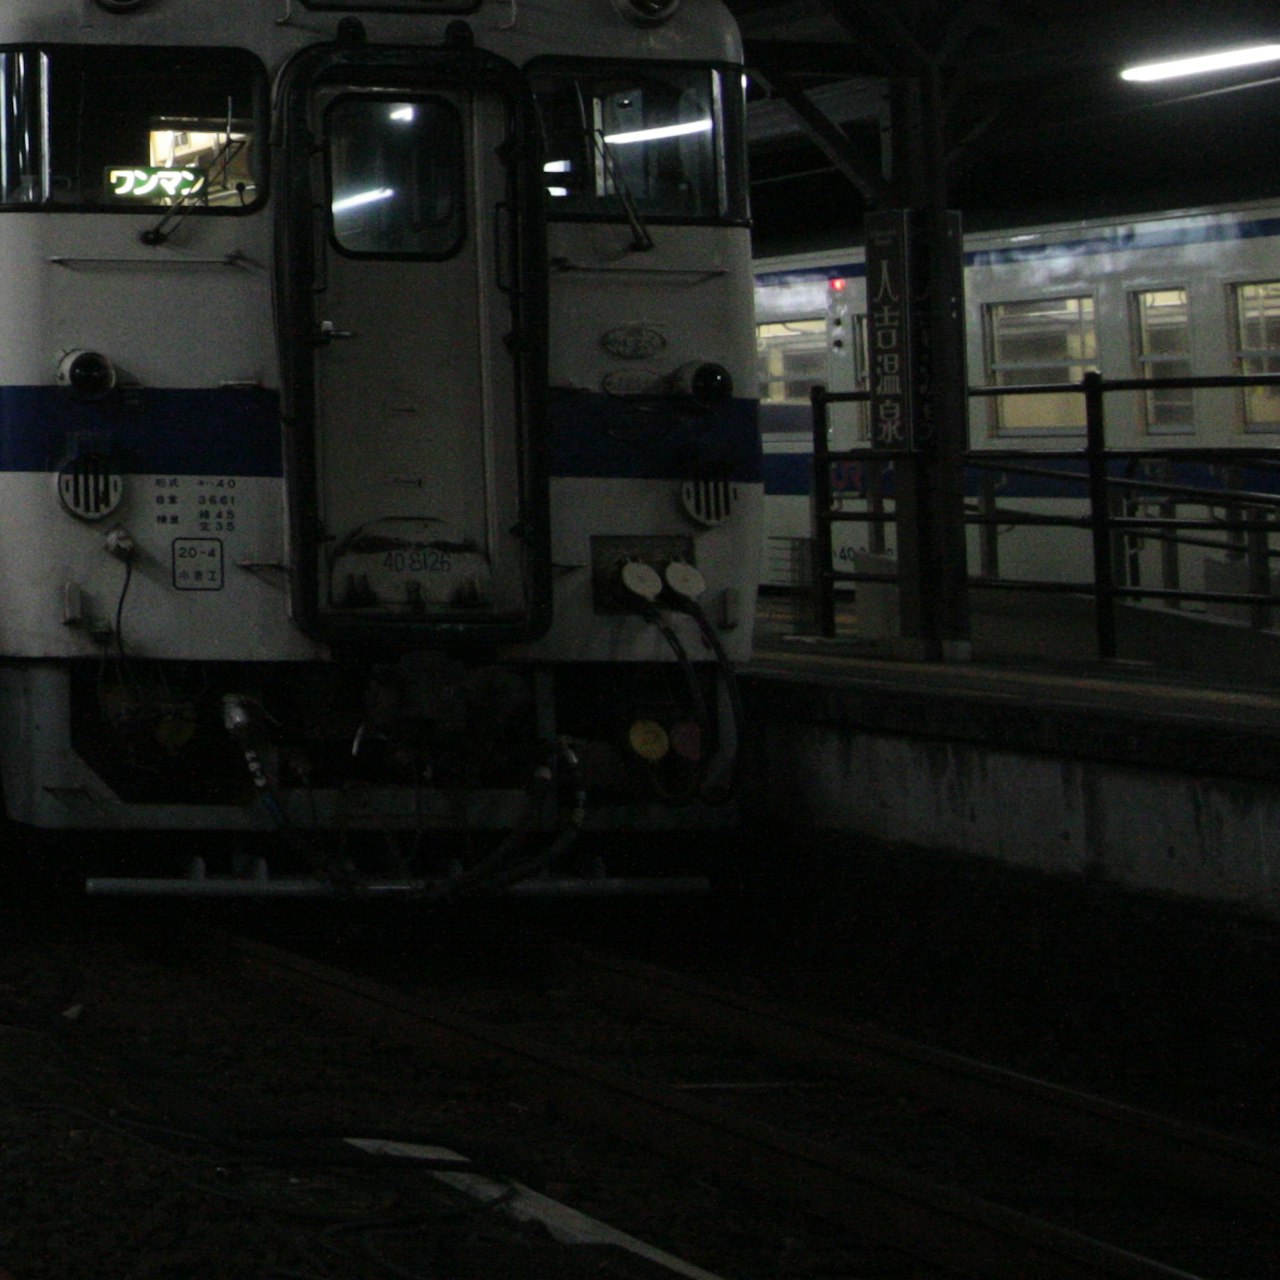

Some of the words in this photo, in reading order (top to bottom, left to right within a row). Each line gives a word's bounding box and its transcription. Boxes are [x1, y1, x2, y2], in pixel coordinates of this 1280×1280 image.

[109, 169, 205, 196] ワンマン
[872, 259, 904, 443] 人吉温泉
[178, 547, 216, 559] 20-4
